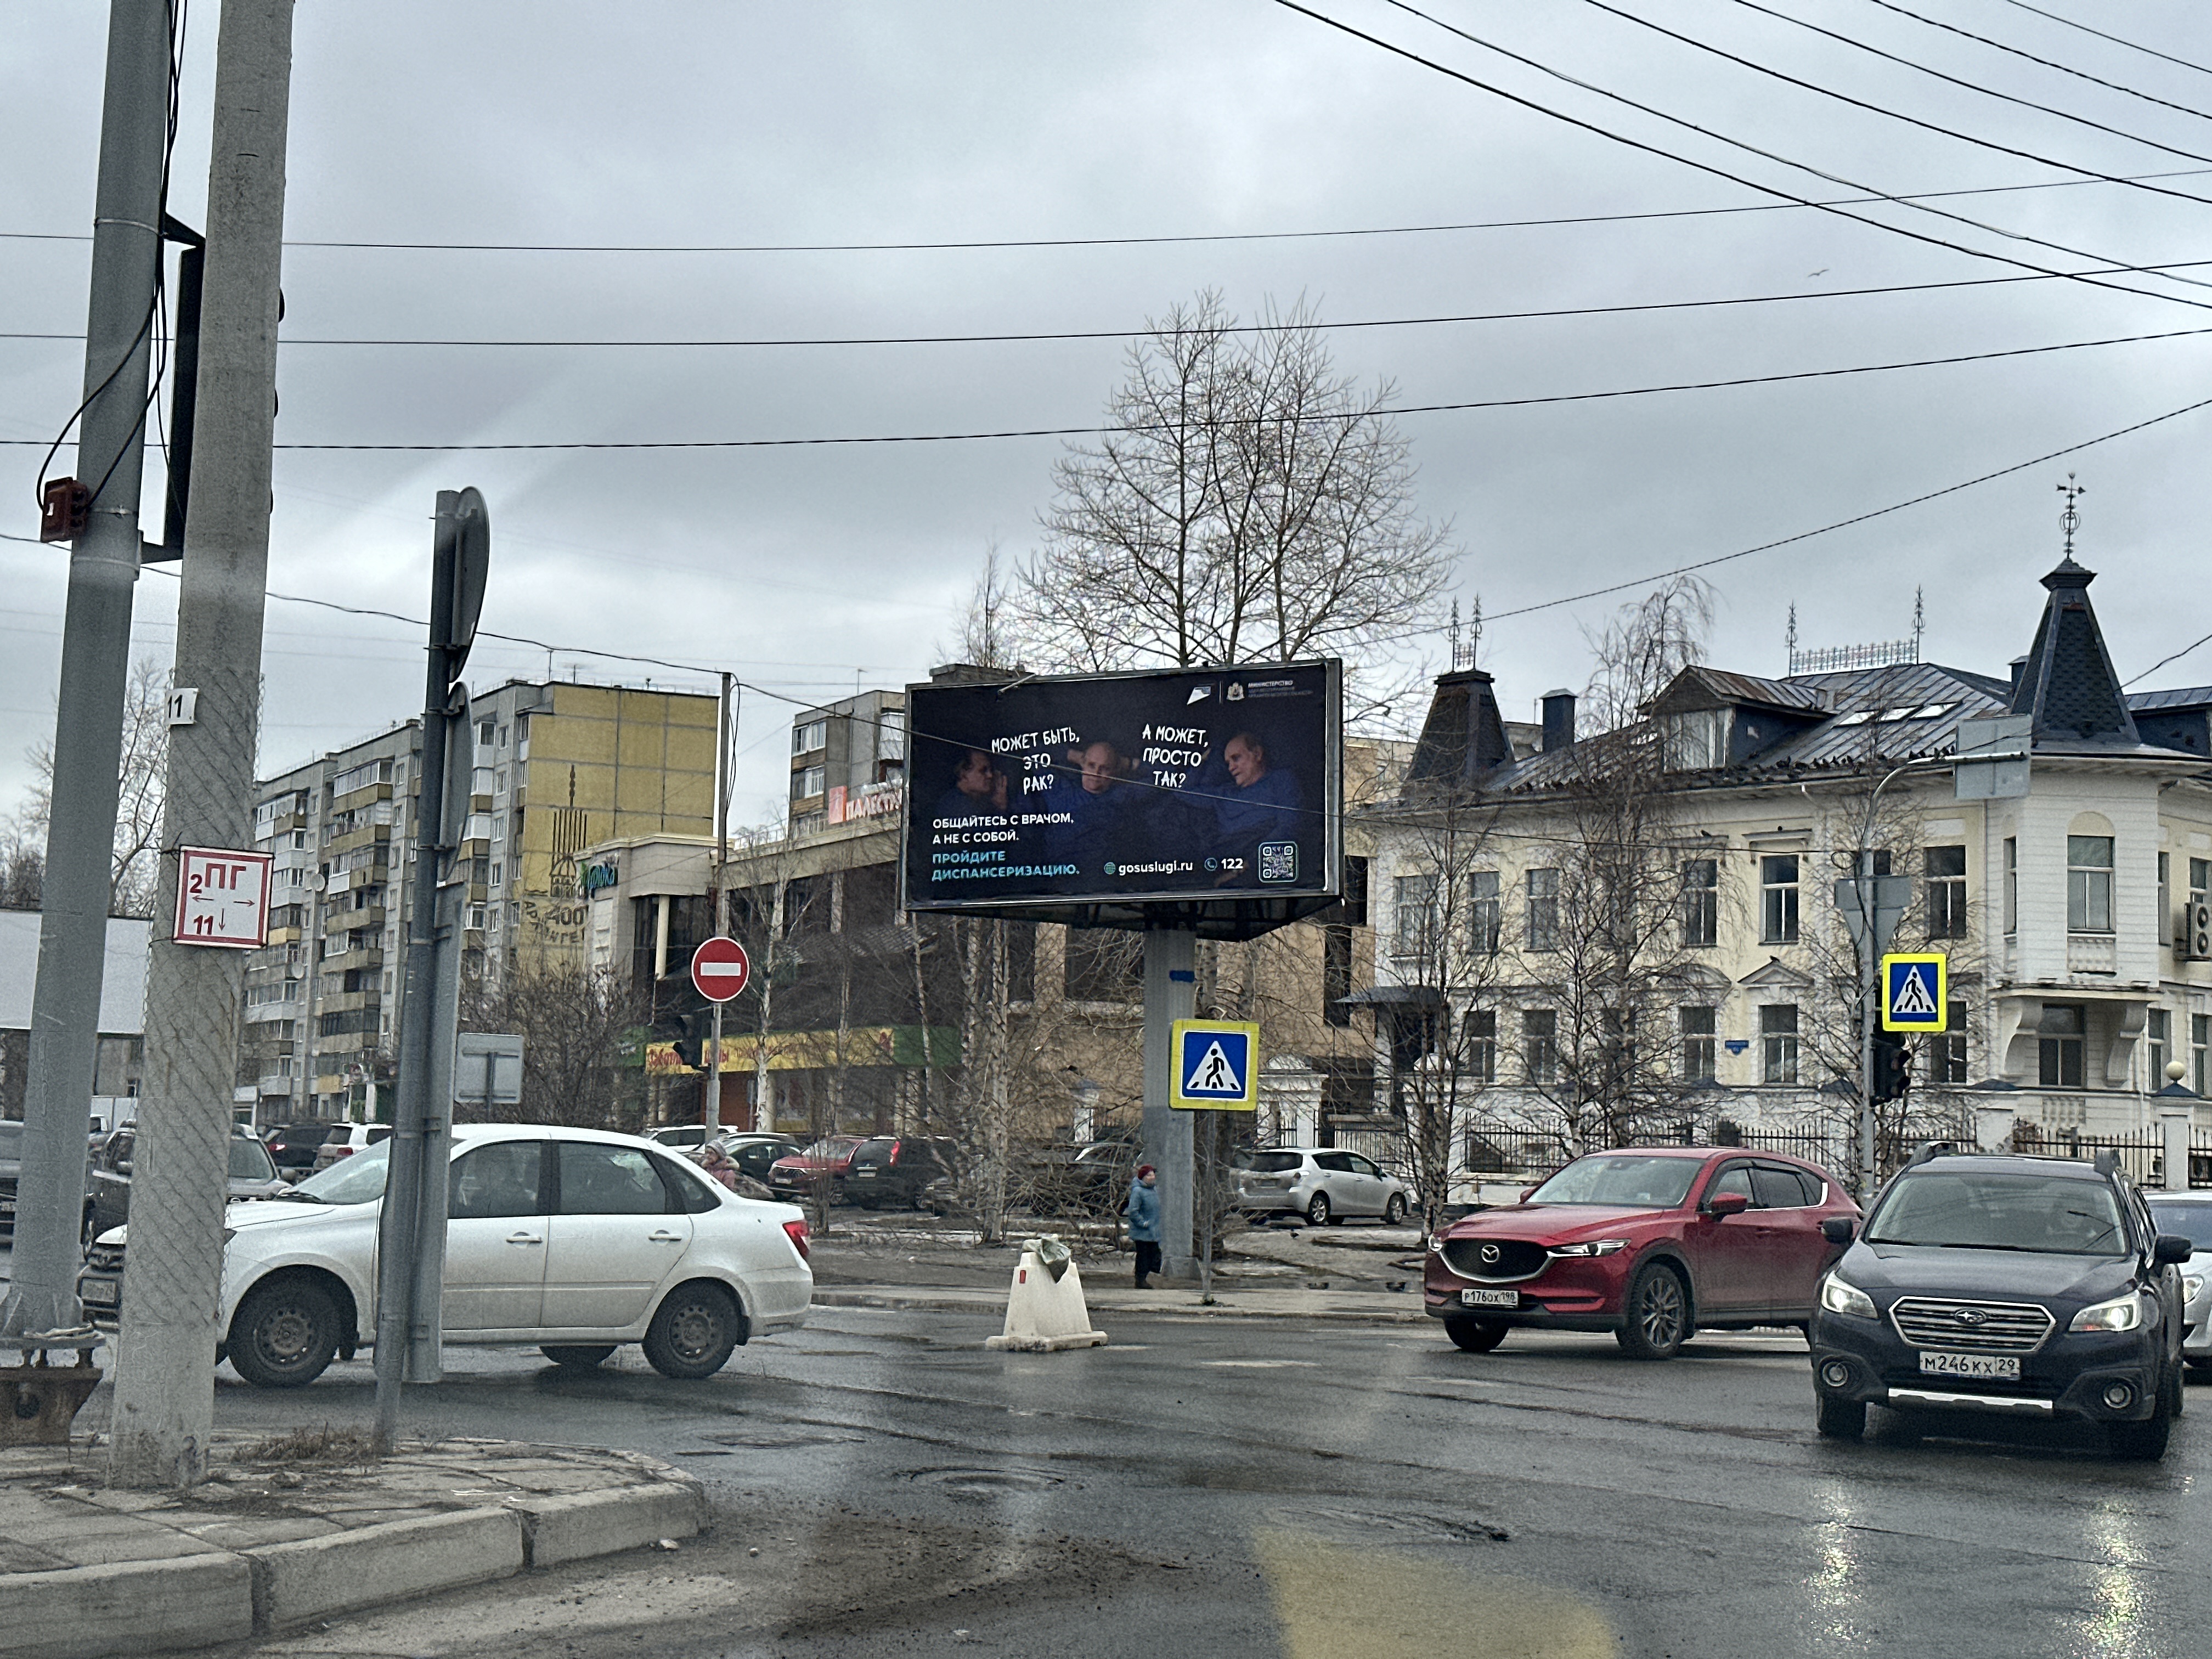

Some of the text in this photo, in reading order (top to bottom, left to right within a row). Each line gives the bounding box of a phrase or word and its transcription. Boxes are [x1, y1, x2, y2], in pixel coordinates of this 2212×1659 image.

[167, 694, 183, 719] 11
[992, 727, 1080, 753] МОЖЕТ БЫТЬ,
[1142, 723, 1209, 747] А МОЖЕТ,
[1023, 753, 1051, 770] ЭТО
[1143, 747, 1202, 767] ПРОСТО
[1023, 774, 1054, 795] РАК?
[1153, 770, 1187, 788] ТАК?
[933, 815, 1007, 829] ОБЩАЙТЕСЬ
[1010, 815, 1019, 825] С
[933, 829, 1020, 844] А НЕ С СОБОЙ.
[933, 850, 1006, 864] ПРОЙДИТЕ
[1221, 858, 1244, 870] 122
[205, 863, 247, 890] ПГ
[932, 864, 1080, 882] ДИСПАНСЕРИЗАЦИЮ.
[1119, 860, 1193, 876] gosuslugi.ru
[189, 873, 202, 894] 2
[193, 915, 214, 935] 11
[1925, 1355, 2016, 1374] М246КХ 29
